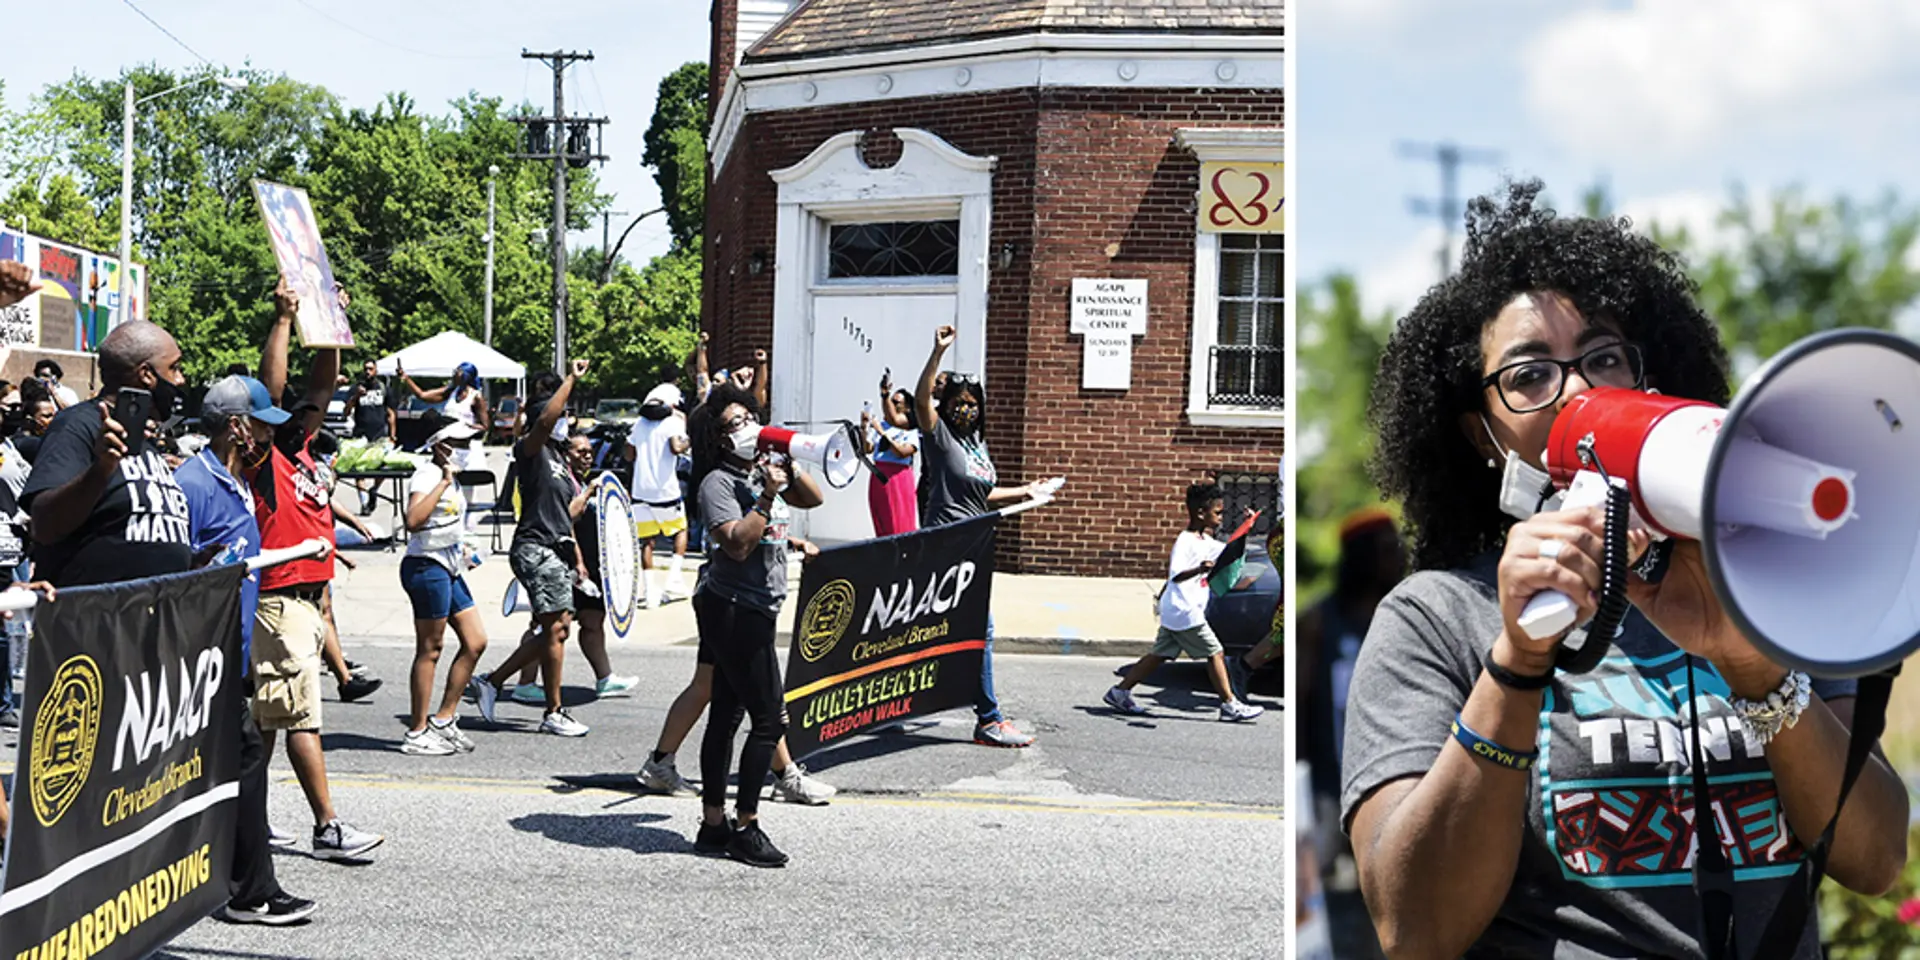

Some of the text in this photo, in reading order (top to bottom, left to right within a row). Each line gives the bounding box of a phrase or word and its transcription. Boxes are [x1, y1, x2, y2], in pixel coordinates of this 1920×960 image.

[1076, 296, 1142, 305] RENAISSANCE
[1095, 284, 1126, 293] AGAPE
[1085, 308, 1132, 317] SPIRITUAL
[1089, 320, 1127, 329] CENTER
[843, 316, 872, 353] 11713
[861, 561, 976, 634] NAACP
[852, 617, 949, 662] Cleveland Branch
[112, 646, 224, 772] NAACP
[802, 659, 939, 729] JUNETEENTH
[819, 696, 912, 742] FREEDOM WALK
[1473, 742, 1515, 766] NAACP
[103, 747, 202, 826] Cleveland Branch
